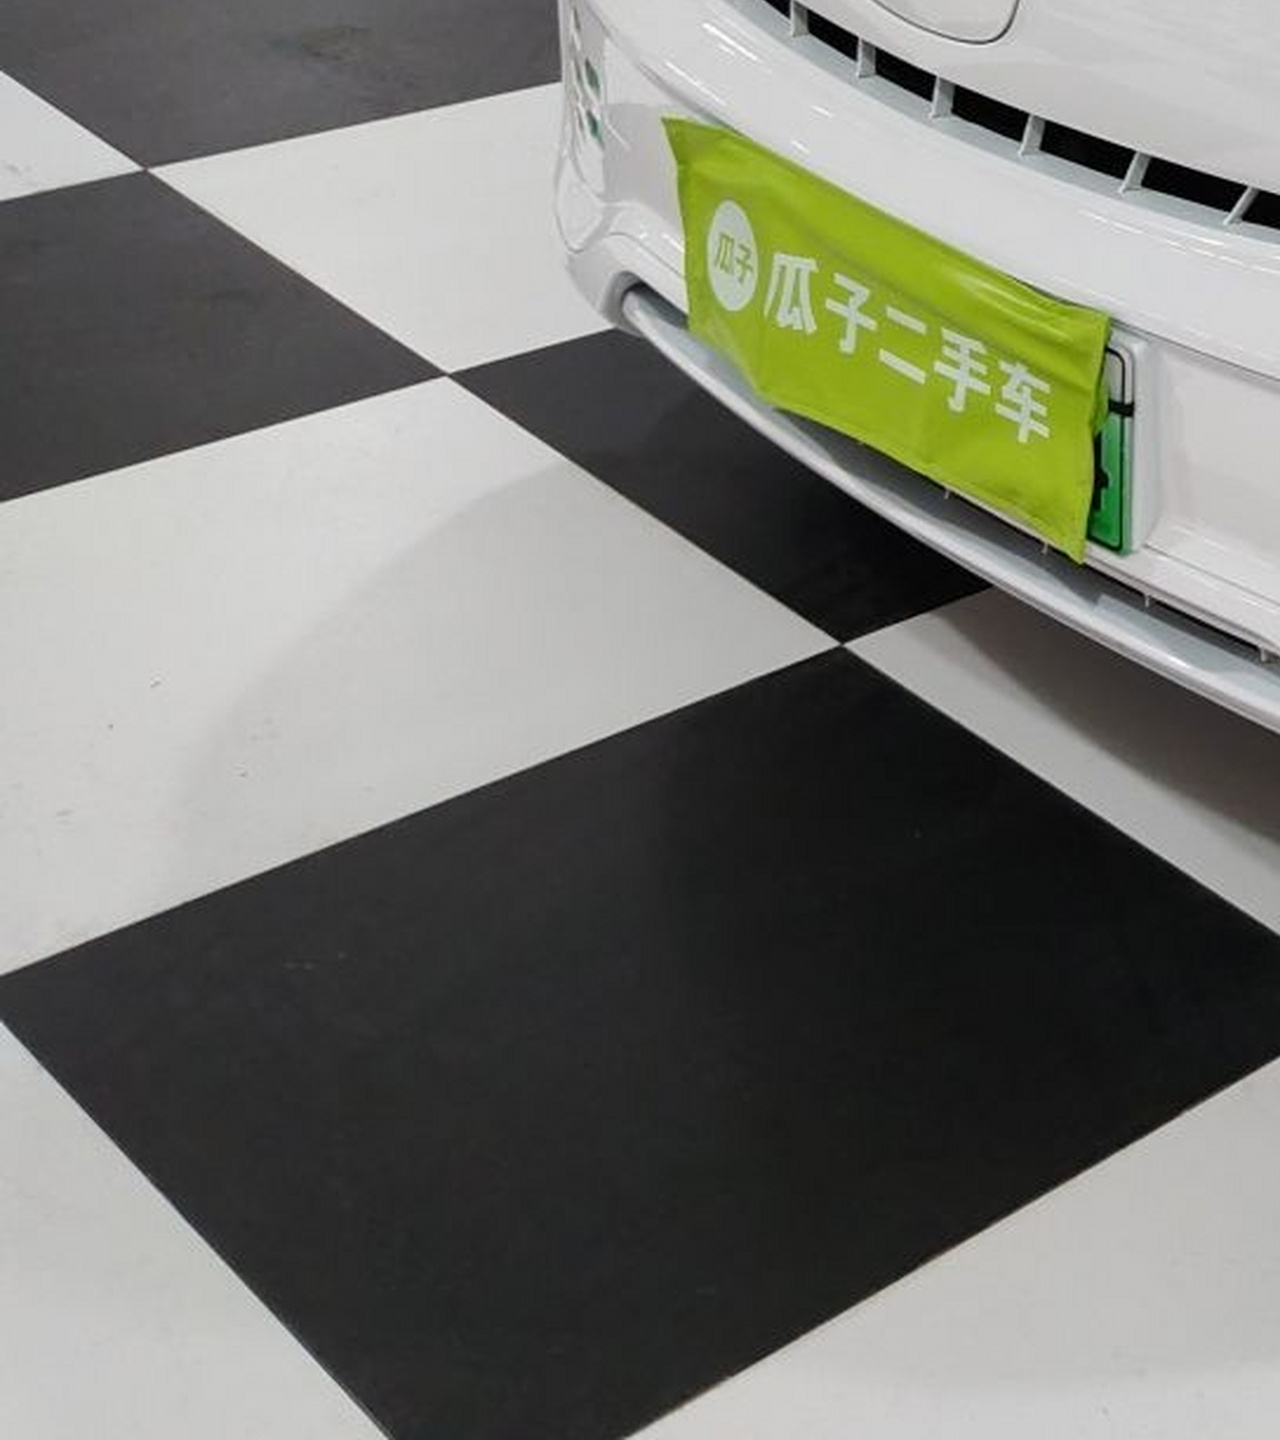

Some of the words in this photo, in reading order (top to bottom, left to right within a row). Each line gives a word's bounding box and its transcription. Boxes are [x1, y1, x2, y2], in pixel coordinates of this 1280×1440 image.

[714, 231, 755, 284] 瓜子
[763, 251, 1052, 444] 瓜子二手车
